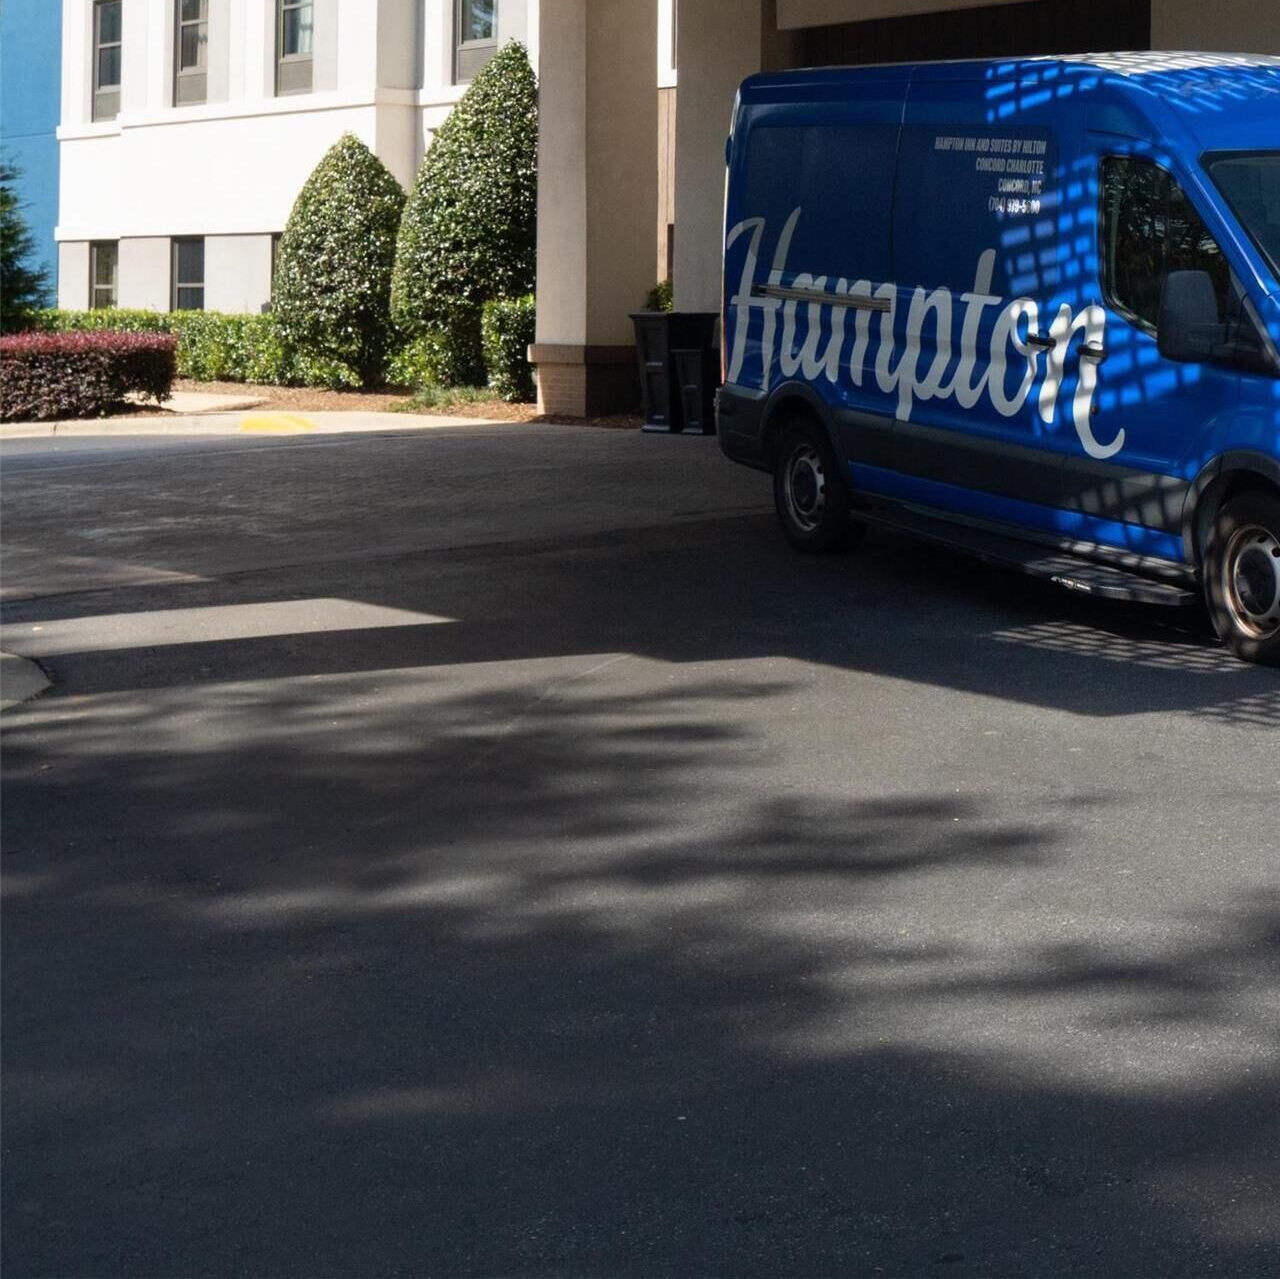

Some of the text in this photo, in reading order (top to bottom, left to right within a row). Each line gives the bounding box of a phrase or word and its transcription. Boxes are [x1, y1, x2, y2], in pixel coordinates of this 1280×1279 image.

[1022, 140, 1047, 154] HILTON
[976, 157, 1044, 174] CONCORD CHARLOTTE
[726, 206, 1125, 459] Hampton
